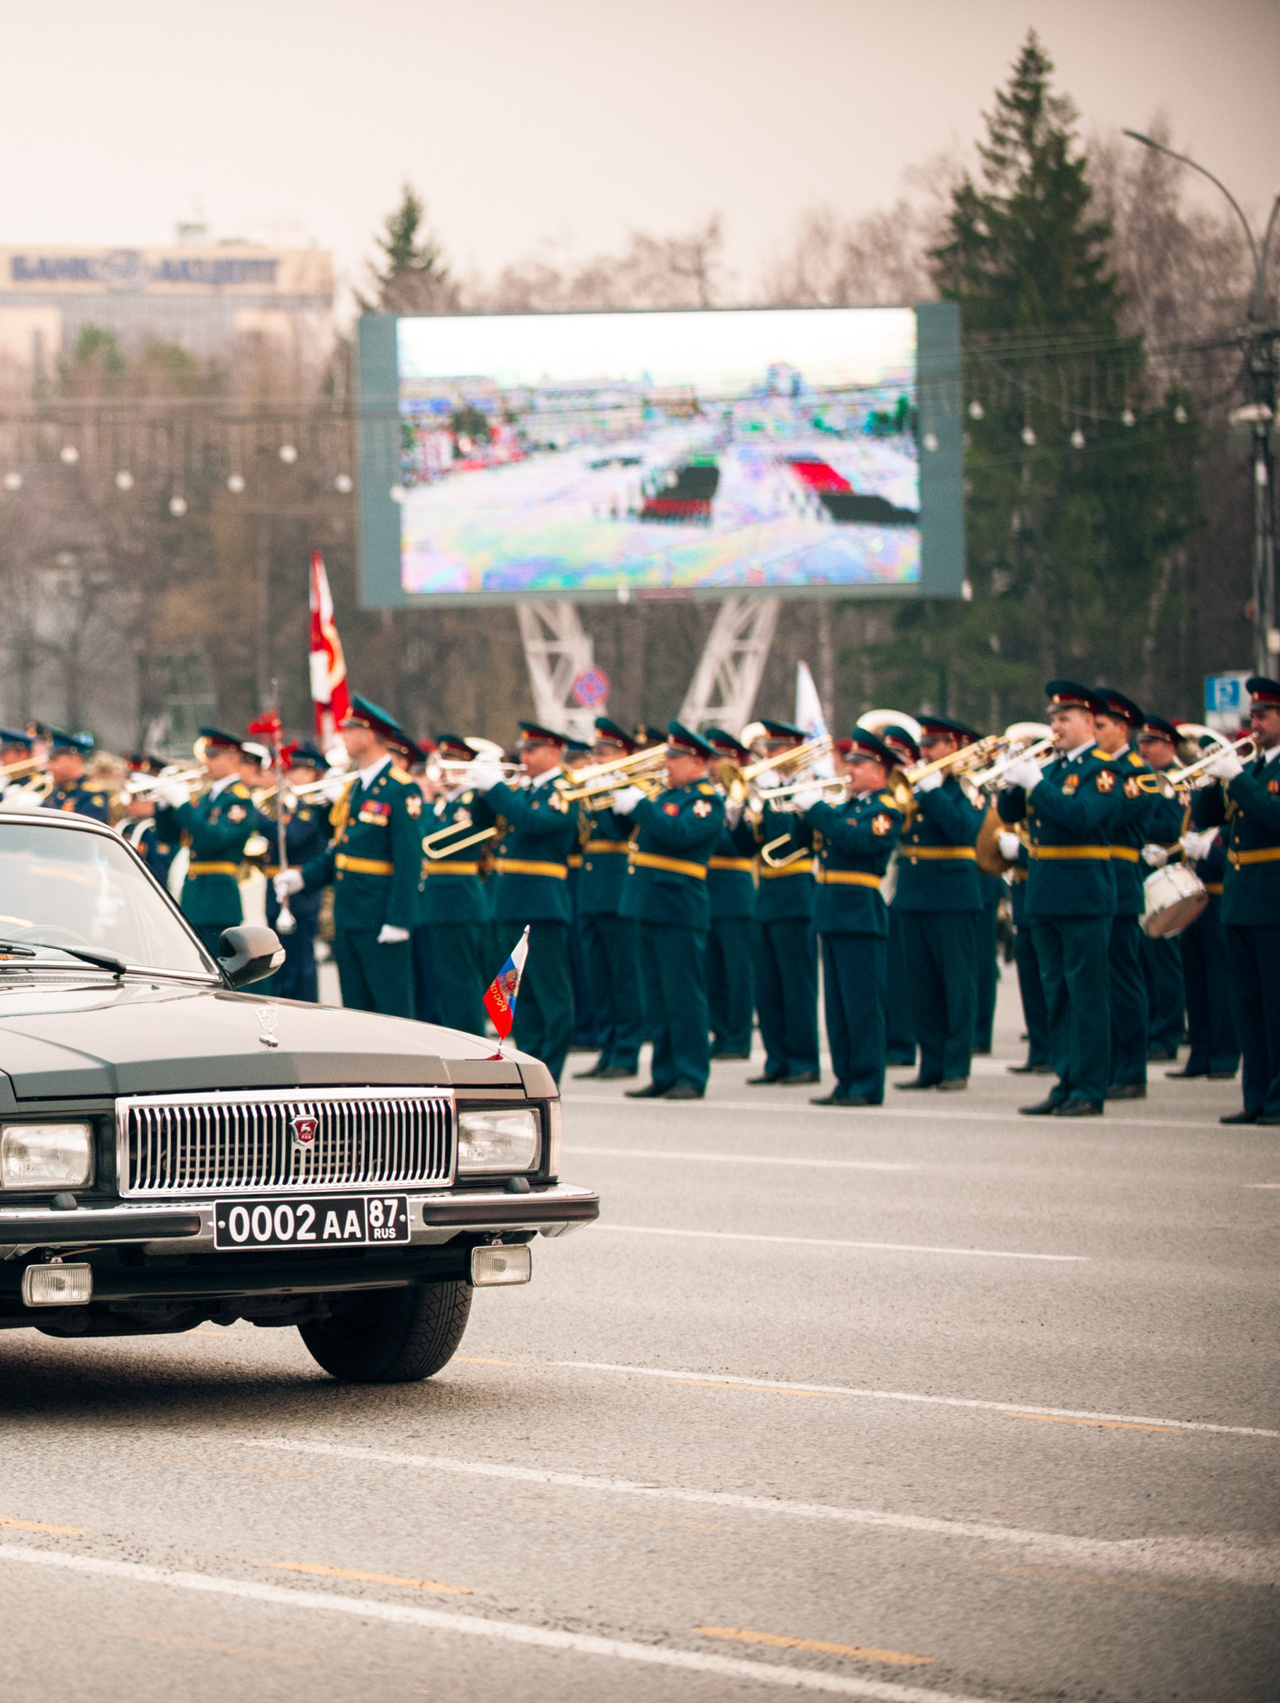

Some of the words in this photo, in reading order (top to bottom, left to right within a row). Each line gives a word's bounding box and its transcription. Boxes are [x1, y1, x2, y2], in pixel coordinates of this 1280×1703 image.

[228, 1203, 317, 1243] 0002
[369, 1199, 399, 1228] 87
[373, 1227, 397, 1240] RUS
